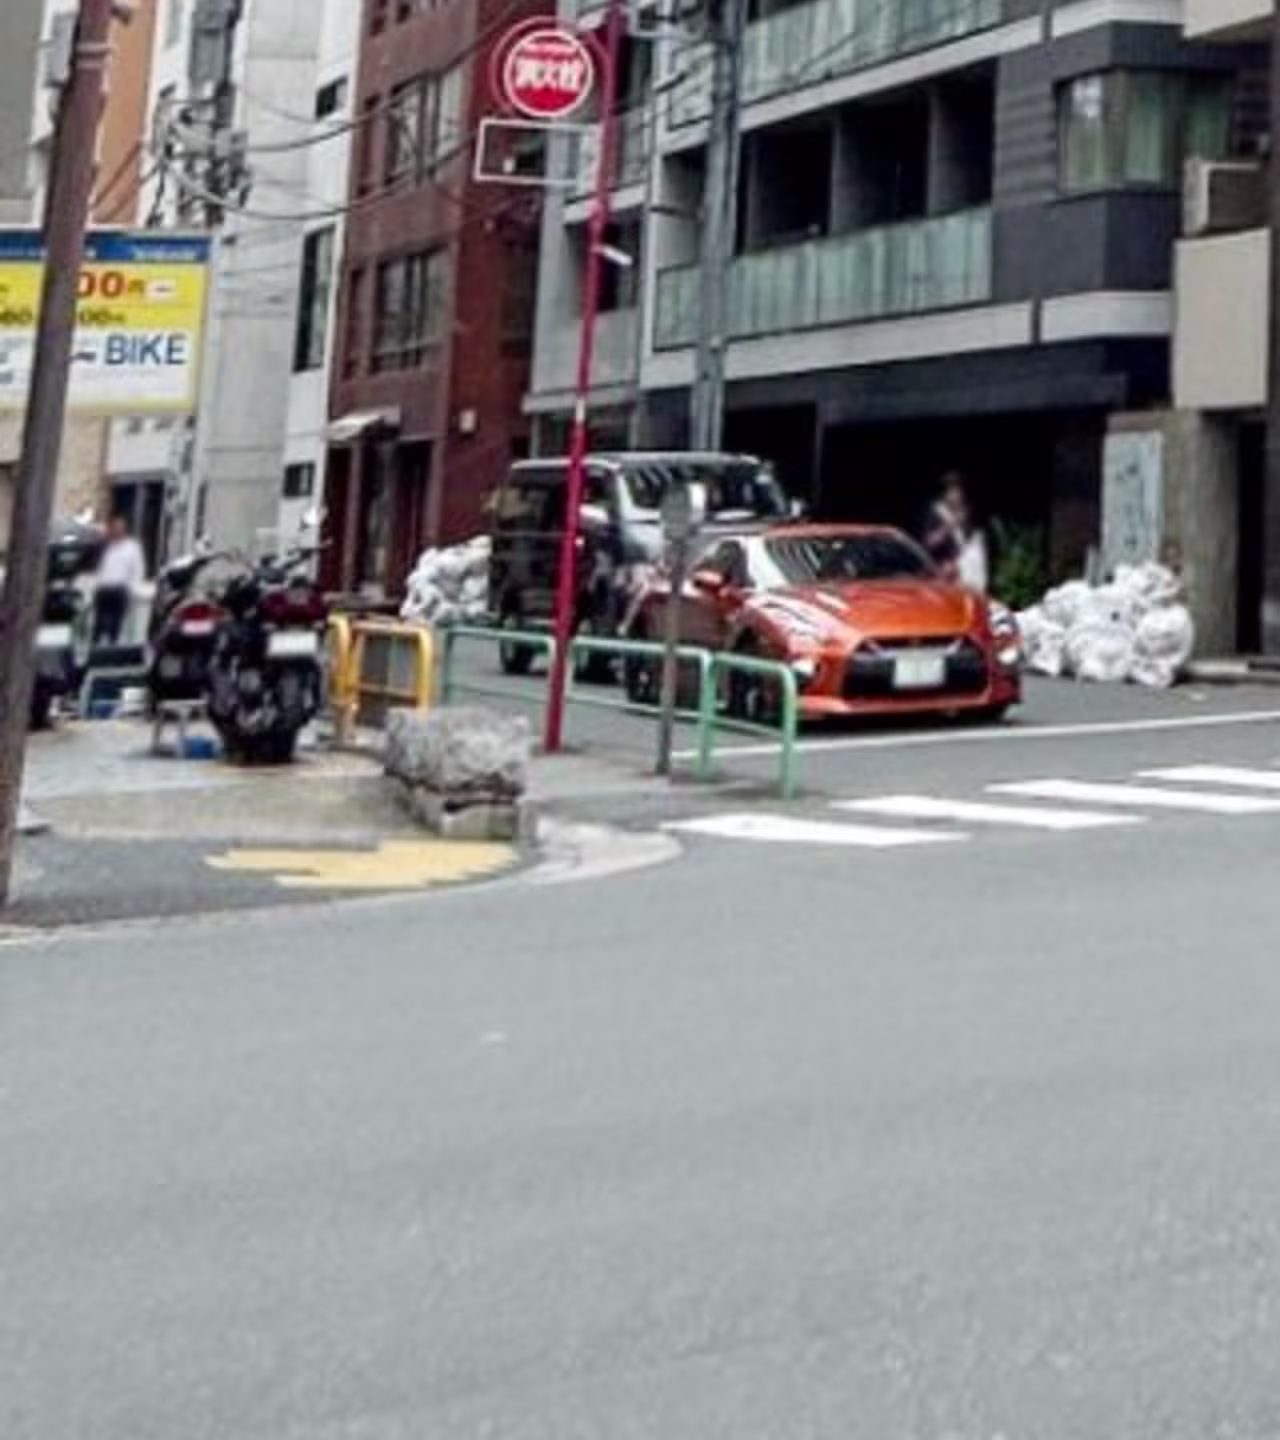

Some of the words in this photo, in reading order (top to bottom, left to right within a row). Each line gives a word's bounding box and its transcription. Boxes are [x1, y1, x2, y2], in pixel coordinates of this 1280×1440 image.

[514, 58, 583, 91] 消火栓
[105, 335, 187, 365] BIKE
